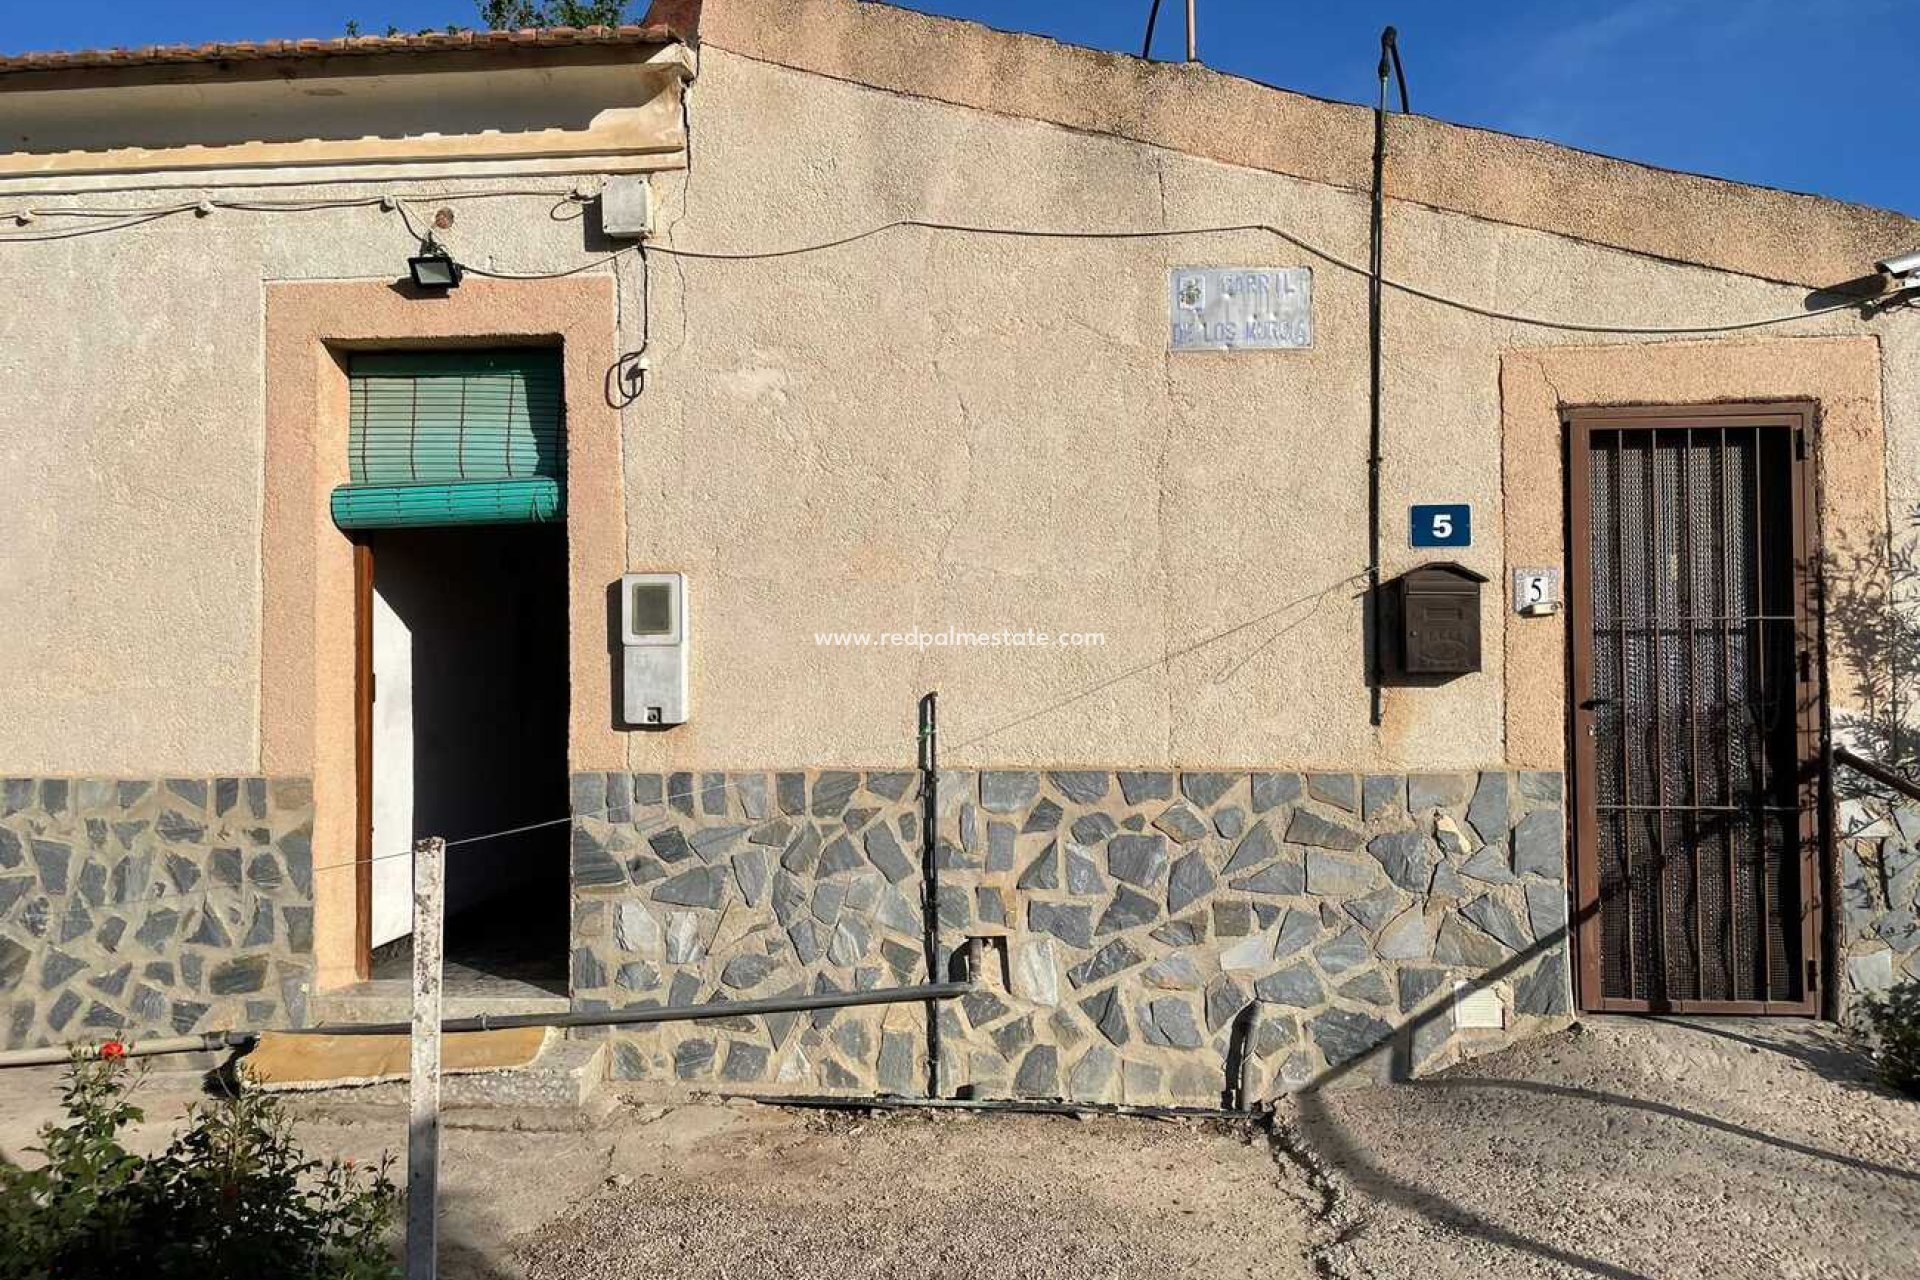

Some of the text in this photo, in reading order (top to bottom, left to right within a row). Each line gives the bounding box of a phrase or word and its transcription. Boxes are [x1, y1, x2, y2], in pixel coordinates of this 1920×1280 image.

[1204, 321, 1236, 342] LOS
[1432, 514, 1453, 538] 5
[1530, 577, 1543, 603] 5
